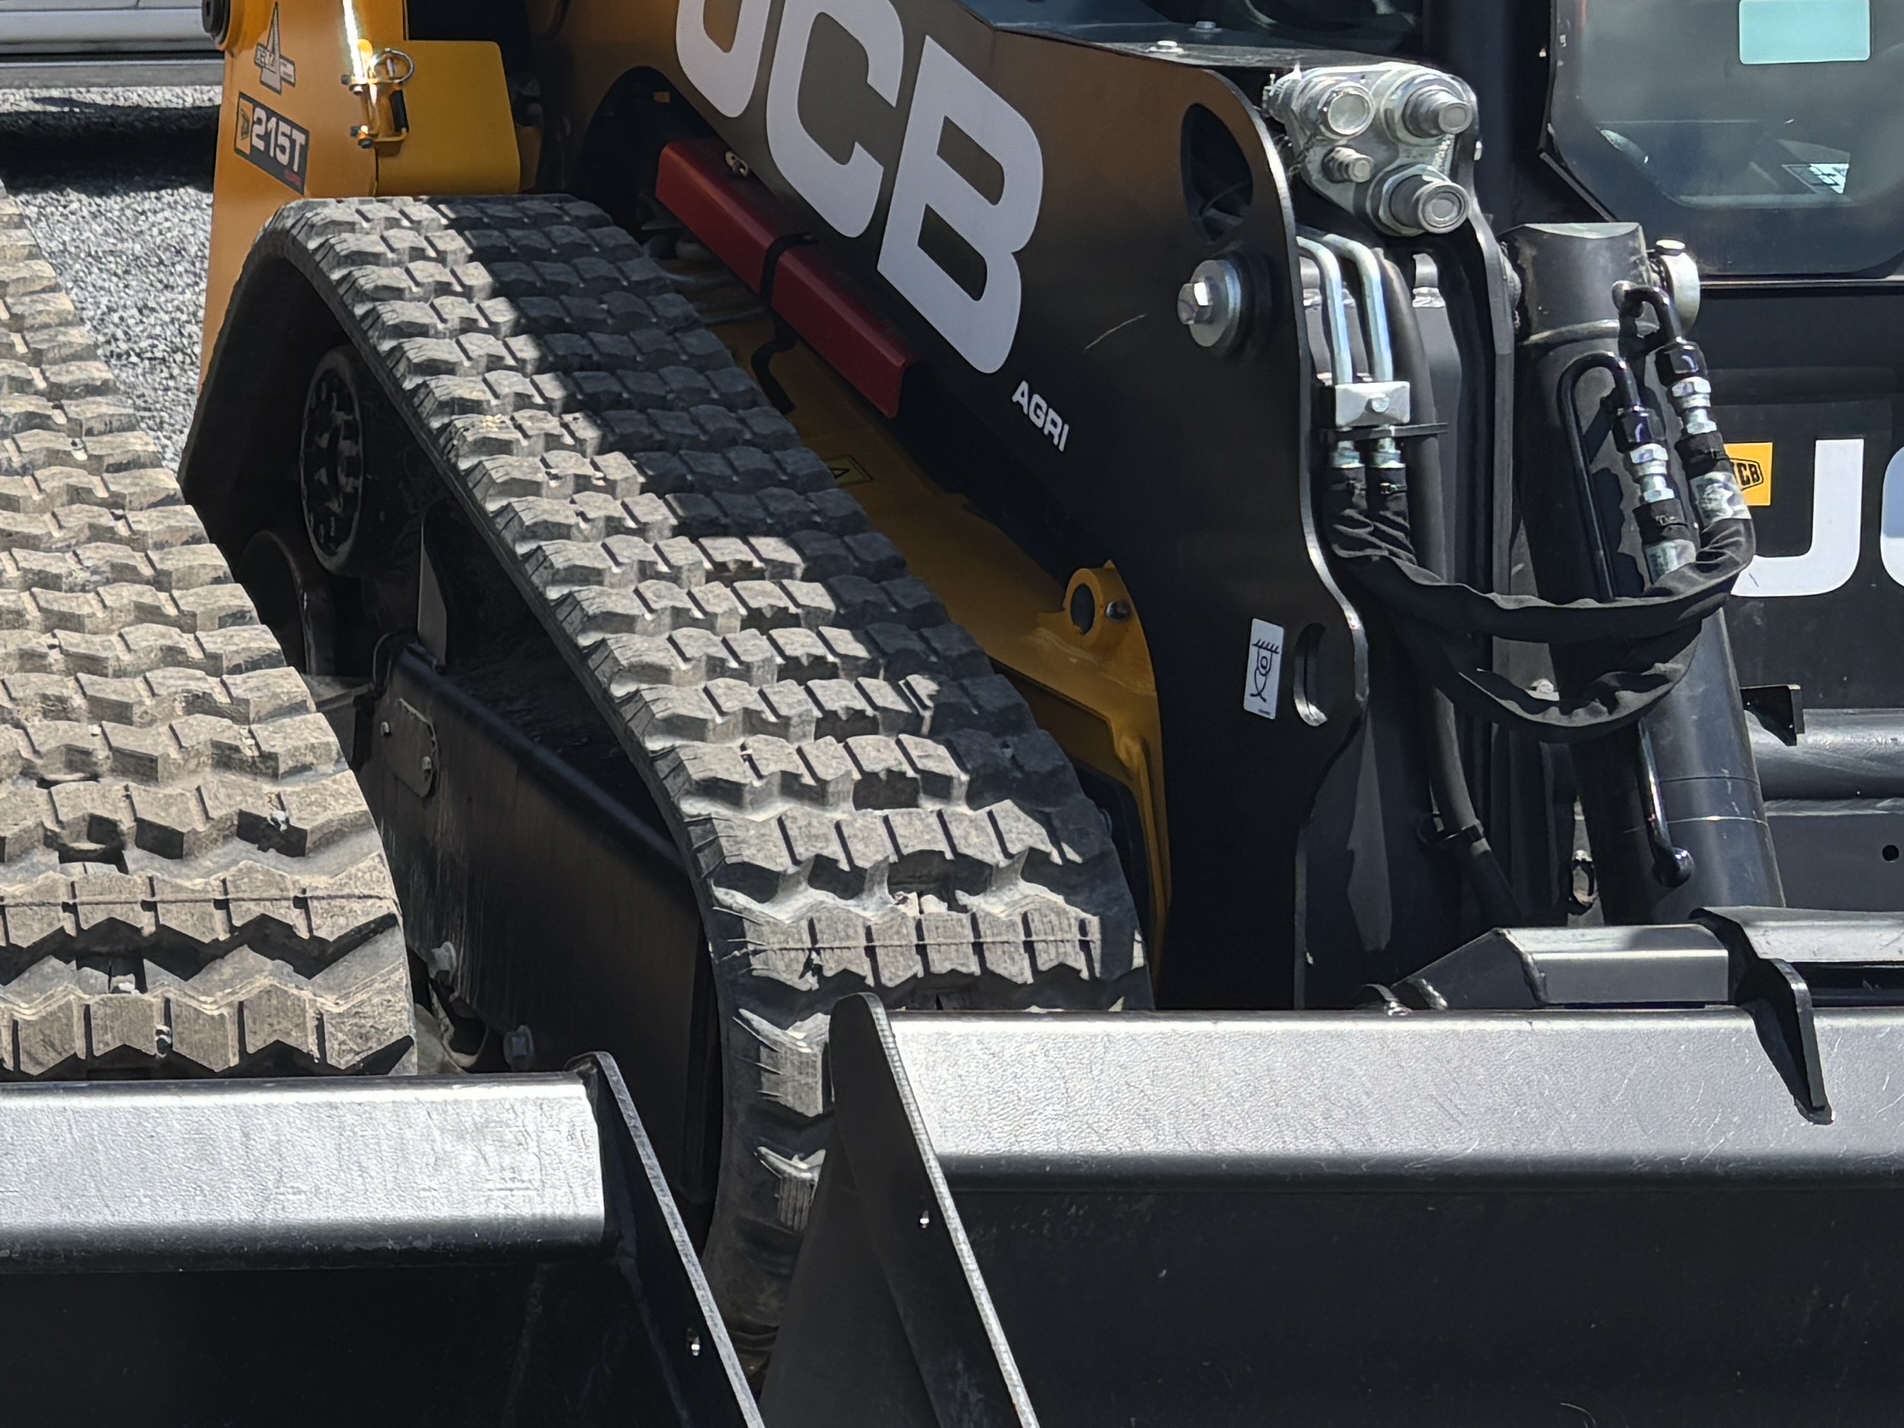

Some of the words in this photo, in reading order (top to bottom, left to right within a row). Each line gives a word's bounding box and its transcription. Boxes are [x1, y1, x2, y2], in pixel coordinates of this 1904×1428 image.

[252, 107, 307, 173] 215T
[1011, 379, 1070, 453] AGRI
[1735, 461, 1762, 487] CB
